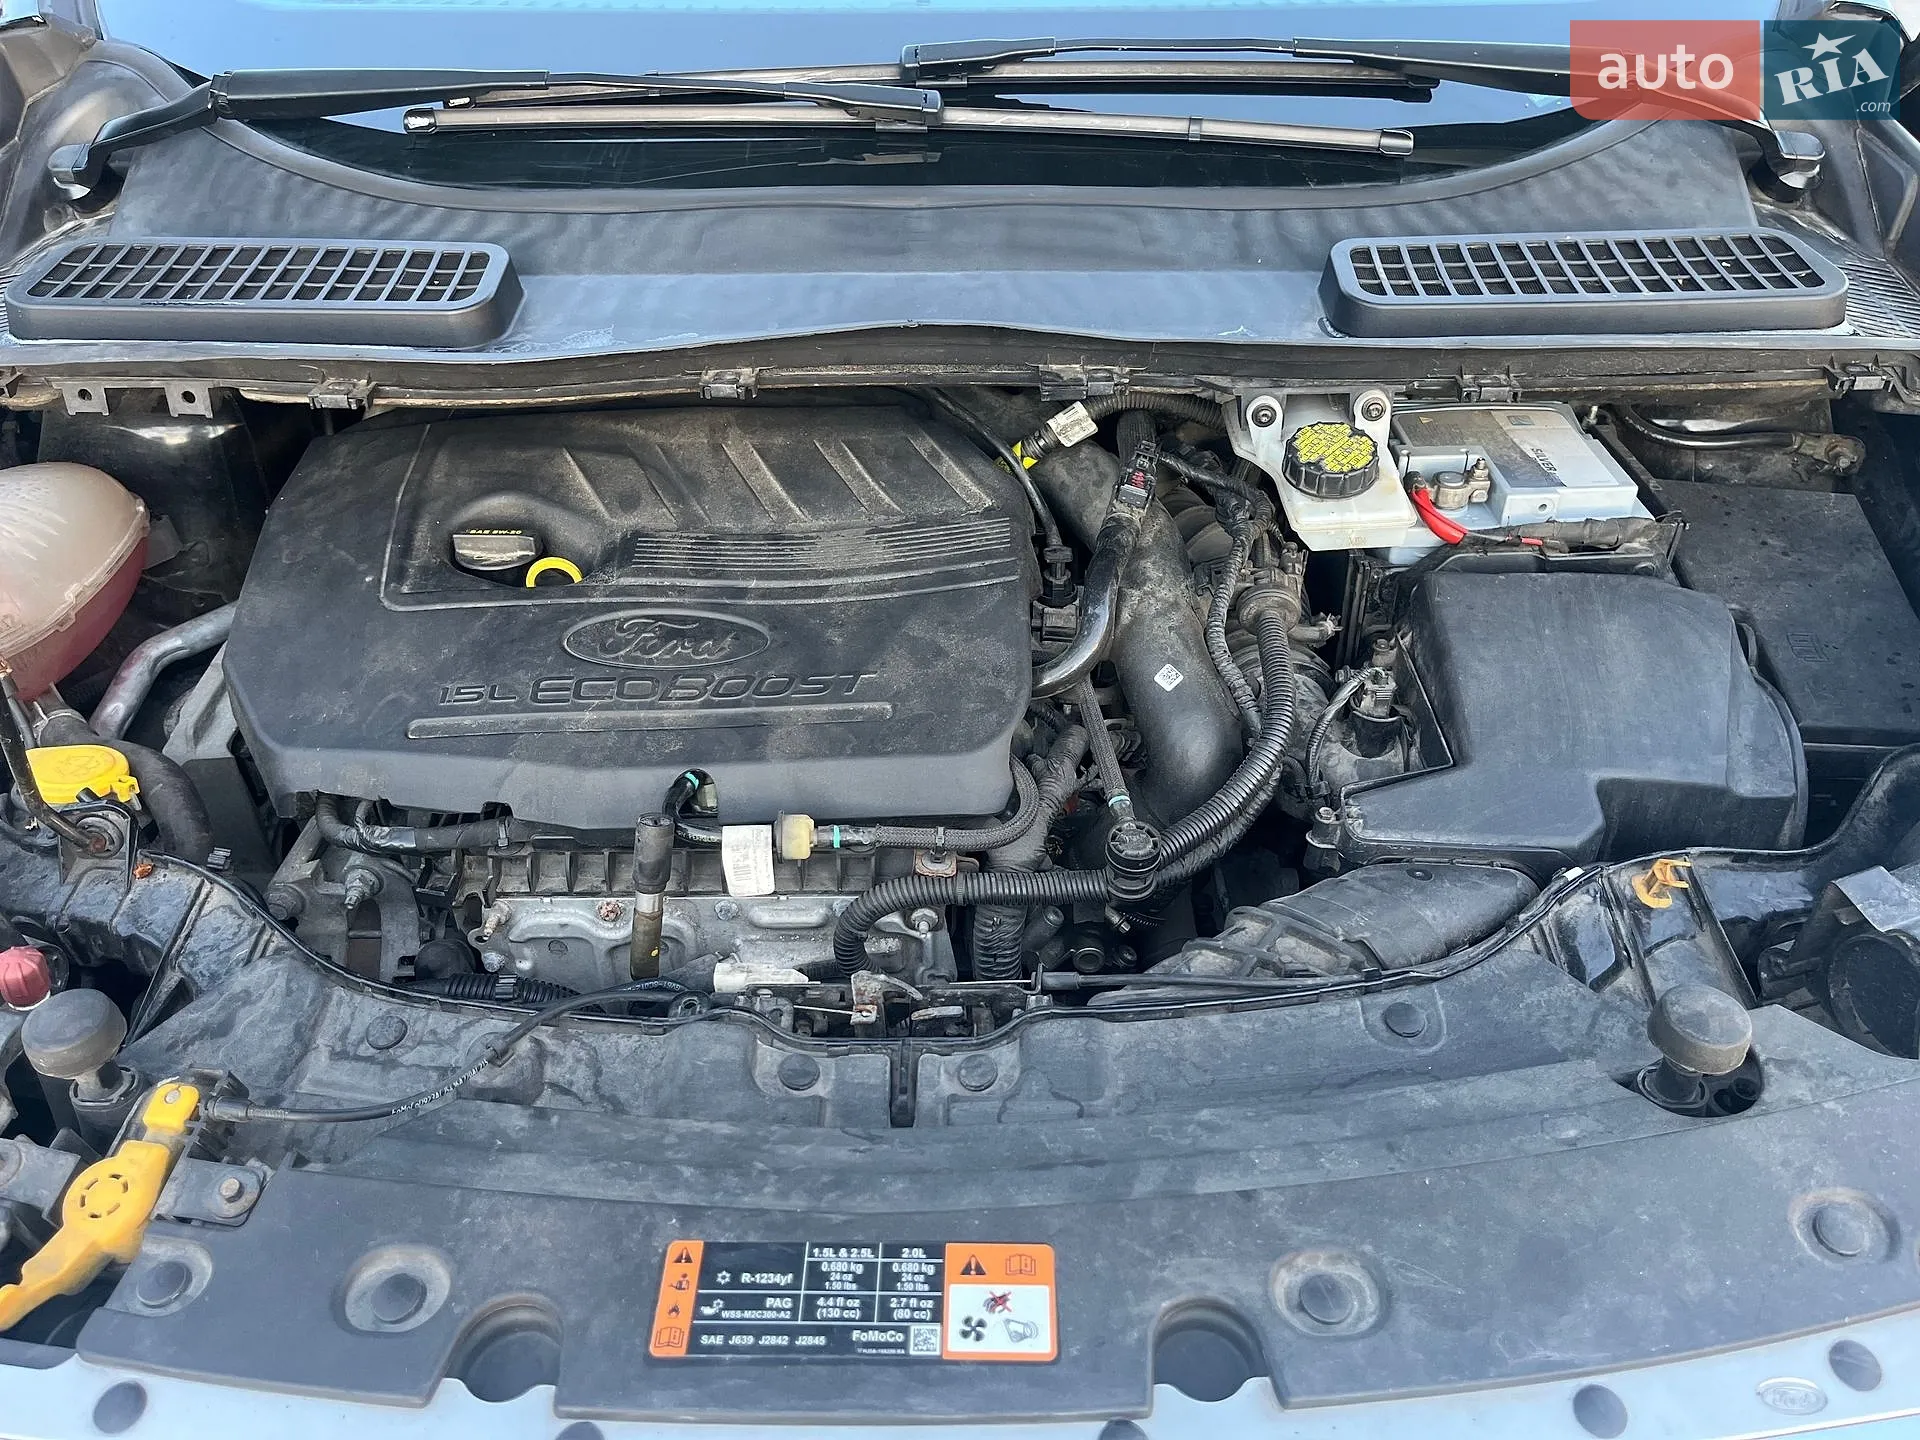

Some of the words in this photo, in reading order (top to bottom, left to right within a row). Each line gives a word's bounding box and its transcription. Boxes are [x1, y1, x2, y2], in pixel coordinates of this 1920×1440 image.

[606, 618, 732, 660] Ford
[528, 670, 878, 704] ECOBOOST
[812, 1247, 836, 1258] 1.5L
[839, 1248, 848, 1258] &
[850, 1248, 875, 1258] 2.5L
[901, 1248, 926, 1258] 2.0L
[850, 1261, 864, 1274] kg
[921, 1262, 936, 1275] kg
[741, 1272, 793, 1286] R-1234yf
[830, 1272, 840, 1281] 24
[901, 1273, 912, 1282] 24
[766, 1297, 792, 1308] PAG
[816, 1297, 834, 1307] 4.4
[846, 1299, 860, 1307] oz
[890, 1298, 907, 1308] 2.7
[919, 1300, 935, 1308] oz
[816, 1308, 840, 1319] (130
[842, 1308, 861, 1319] cc)
[913, 1309, 931, 1320] cc)
[700, 1335, 724, 1345] SAE
[728, 1335, 755, 1345] J639
[758, 1335, 789, 1345] J2842
[795, 1335, 827, 1345] J2845
[852, 1330, 905, 1341] FoMoCo
